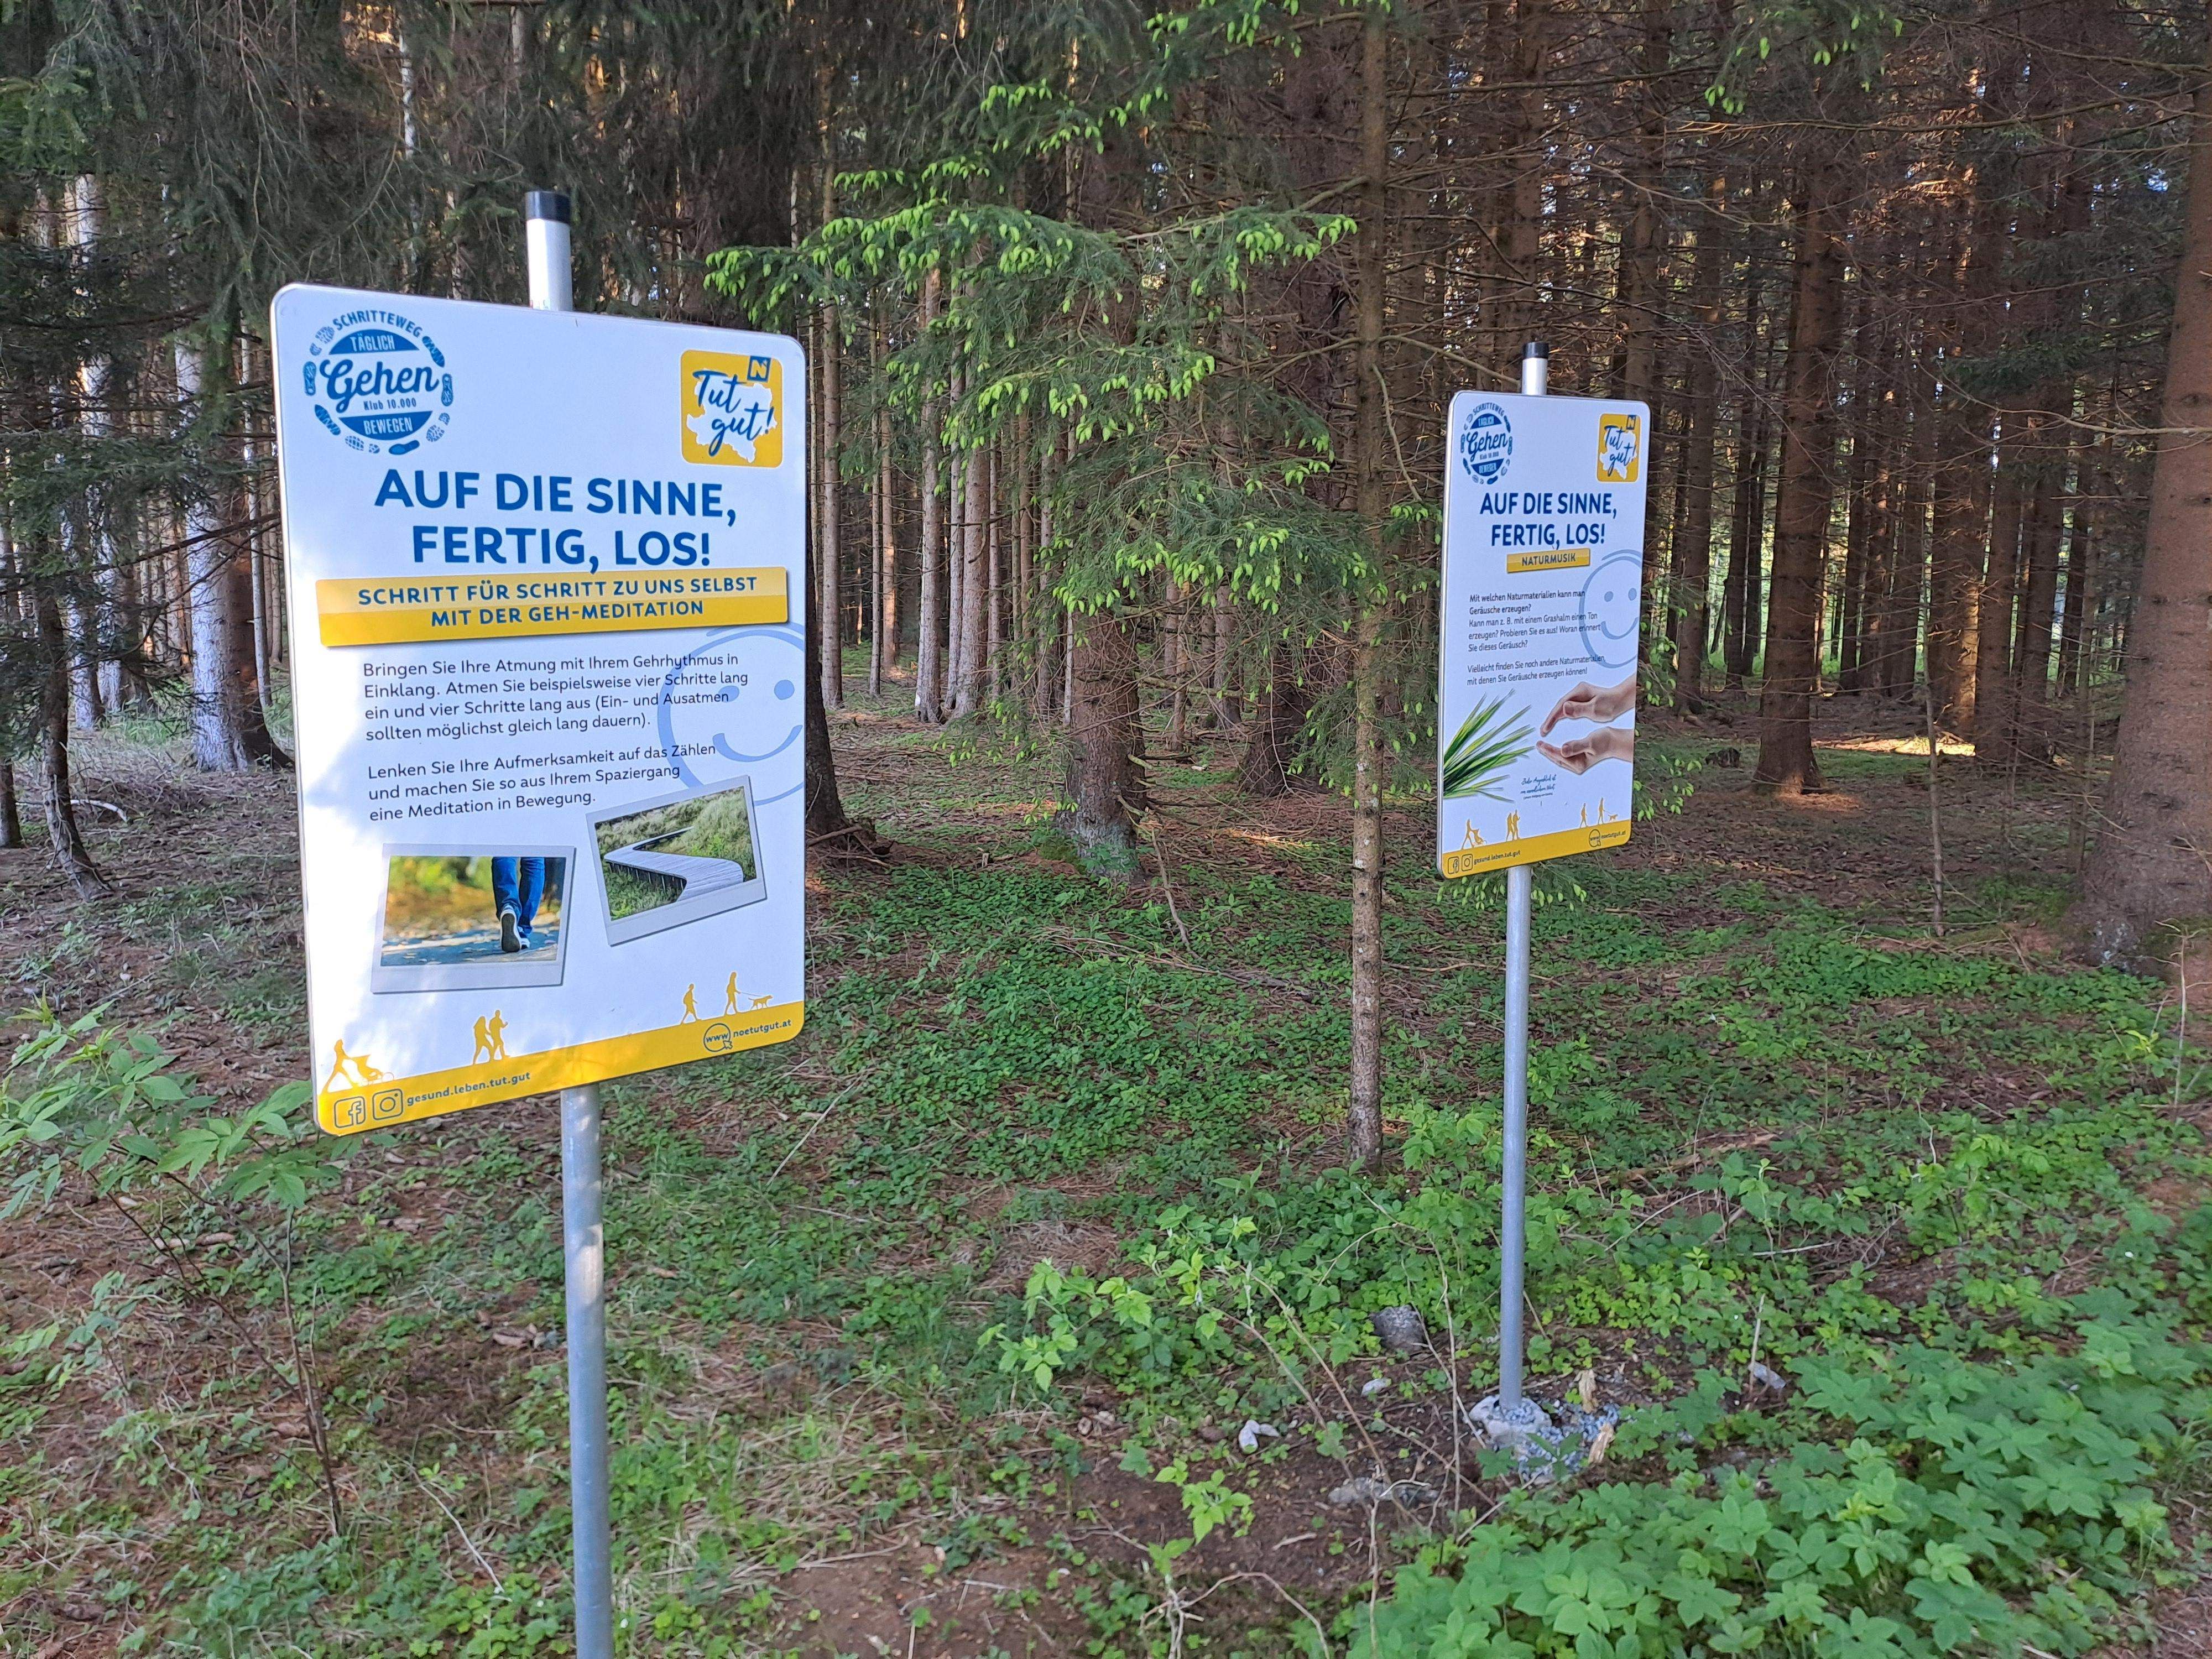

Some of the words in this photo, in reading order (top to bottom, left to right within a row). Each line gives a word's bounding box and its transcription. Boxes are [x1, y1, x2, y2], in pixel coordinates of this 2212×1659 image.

[333, 310, 422, 337] SCHRITTEWEG
[350, 333, 395, 352] TÄGLICH
[320, 359, 439, 413] Gehen
[692, 371, 747, 413] Tut
[364, 400, 383, 410] Klub
[388, 398, 416, 409] 10.000
[1473, 403, 1504, 416] SCHRITTEWEG
[363, 417, 413, 435] BEWEGEN
[709, 402, 774, 456] gut!
[1604, 425, 1626, 450] Tut
[1467, 431, 1508, 462] Gehen
[1608, 442, 1636, 477] gut!
[374, 469, 480, 510] AUF
[497, 474, 573, 512] DIE
[586, 477, 737, 526] SINNE,
[1480, 493, 1518, 514] AUF
[1524, 493, 1552, 514] DIE
[1557, 493, 1616, 519] SINNE,
[1491, 524, 1559, 550] FERTIG,
[1566, 523, 1605, 544] LOS!
[413, 526, 599, 574] FERTIG,
[615, 529, 711, 567] LOS!
[1522, 553, 1575, 566] NATURMUSIK
[358, 587, 459, 605] SCHRITT
[467, 580, 510, 601] FÜR
[516, 581, 607, 599] SCHRITT
[613, 580, 638, 596] ZU
[645, 580, 685, 595] UNS
[690, 576, 757, 592] SELBST
[1481, 593, 1505, 602] welchen
[1507, 591, 1556, 601] Naturmaterialien
[431, 611, 471, 627] MIT
[479, 608, 523, 625] DER
[528, 601, 703, 622] GEH-MEDITATION
[1469, 606, 1500, 614] Geräusche
[1501, 604, 1531, 614] erzeugen?
[1543, 613, 1570, 622] Grashalm
[1469, 630, 1498, 640] erzeugen?
[1500, 629, 1527, 637] Probieren
[1499, 640, 1528, 650] Geräusch?
[363, 662, 427, 679] Bringen
[432, 661, 456, 674] Sie
[462, 660, 491, 672] Ihre
[495, 658, 556, 674] Atmung
[561, 657, 585, 670] mit
[589, 656, 629, 669] Ihrem
[633, 654, 723, 669] Gehrhythmus
[727, 653, 738, 665] in
[1467, 663, 1494, 672] Vielleicht
[1496, 662, 1514, 670] finden
[1525, 659, 1538, 667] noch
[1540, 658, 1558, 666] andere
[1467, 677, 1477, 685] mit
[1508, 672, 1537, 681] Geräusche
[1539, 670, 1564, 679] erzeugen
[1566, 667, 1587, 676] können!
[364, 682, 440, 699] Einklang.
[446, 682, 498, 695] Atmen
[503, 680, 525, 692] Sie
[530, 676, 631, 693] beispielsweise
[635, 675, 661, 686] vier
[665, 672, 717, 686] Schritte
[721, 671, 748, 686] lang
[365, 707, 389, 719] ein
[394, 703, 425, 718] und
[430, 703, 460, 716] vier
[465, 700, 525, 714] Schritte
[530, 698, 561, 711] lang
[566, 699, 591, 710] aus
[596, 695, 629, 711] (Ein-
[633, 693, 659, 706] und
[663, 692, 729, 705] Ausatmen
[366, 726, 421, 740] sollten
[427, 721, 504, 739] möglichst
[508, 717, 552, 735] gleich
[557, 717, 588, 732] lang
[592, 713, 650, 728] dauern).
[368, 763, 426, 779] Lenken
[431, 761, 455, 774] Sie
[460, 759, 489, 772] Ihre
[494, 750, 614, 770] Aufmerksamkeit
[618, 747, 640, 761] auf
[644, 746, 667, 759] das
[671, 743, 716, 757] Zählen
[369, 785, 399, 800] und
[405, 781, 467, 797] machen
[472, 779, 495, 791] Sie
[499, 779, 516, 789] so
[520, 776, 545, 788] aus
[550, 772, 591, 785] Ihrem
[596, 766, 680, 784] Spaziergang
[370, 809, 403, 821] eine
[408, 800, 493, 818] Meditation
[498, 797, 511, 810] in
[516, 792, 596, 808] Bewegung.
[705, 1032, 729, 1042] www
[733, 1019, 791, 1037] noetutgut.at
[408, 1072, 530, 1106] gesund.leben.tut.gut
